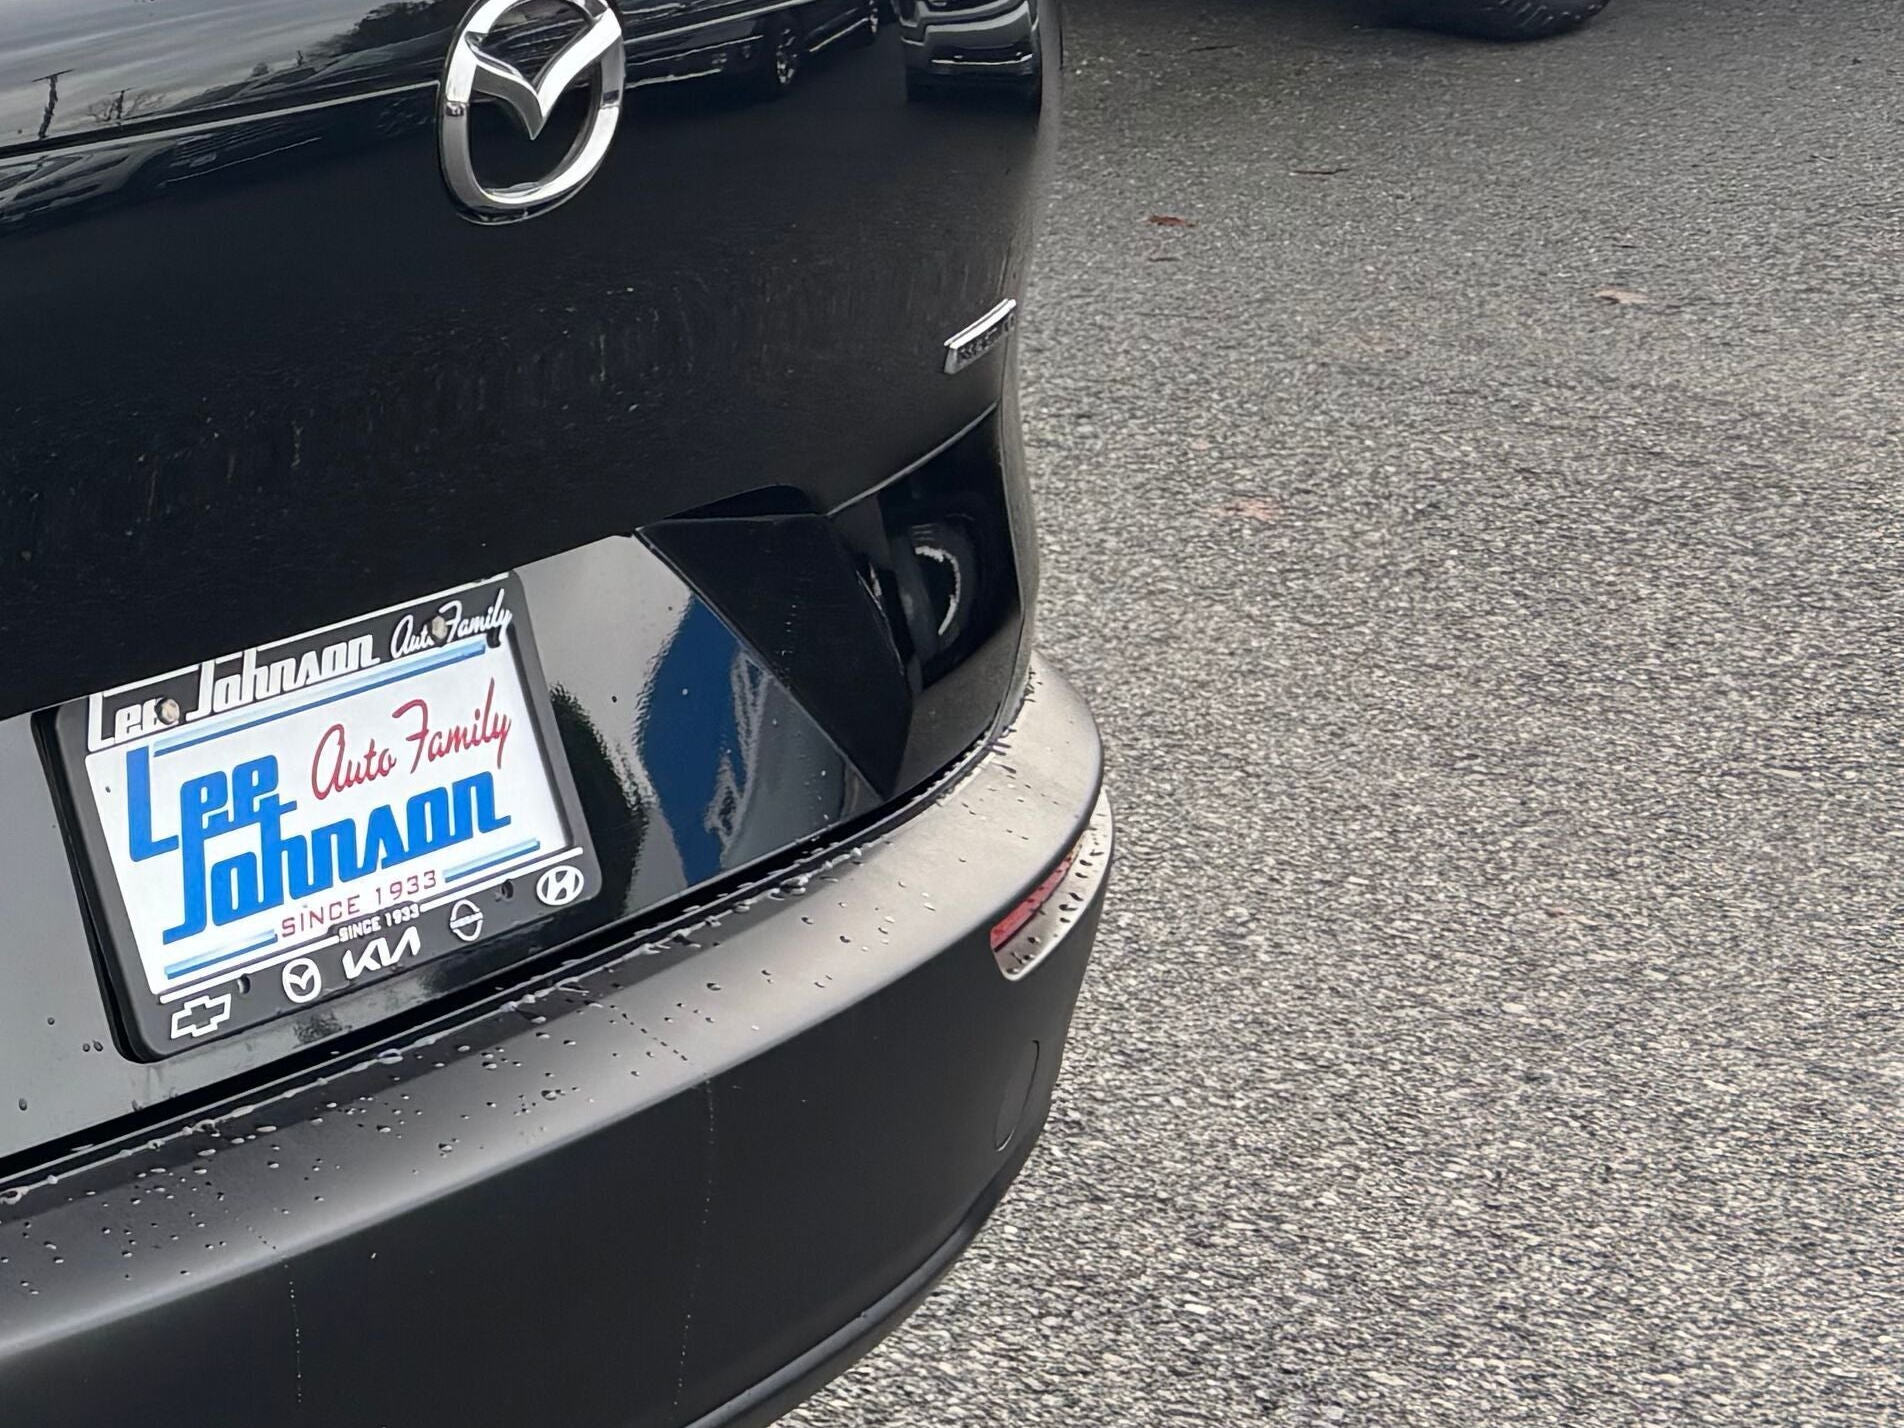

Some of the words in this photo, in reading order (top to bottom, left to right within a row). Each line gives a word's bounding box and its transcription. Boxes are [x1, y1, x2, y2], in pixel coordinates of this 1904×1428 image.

[185, 634, 381, 721] Johnson
[391, 614, 438, 660] Aut
[439, 587, 512, 647] Family
[310, 722, 396, 800] Auto
[391, 677, 511, 769] Family
[126, 745, 296, 862] Lee
[162, 771, 511, 945] Johnson
[281, 894, 361, 938] SINCE
[375, 869, 437, 906] 1933
[338, 915, 381, 943] SINCE
[384, 903, 421, 927] 1933
